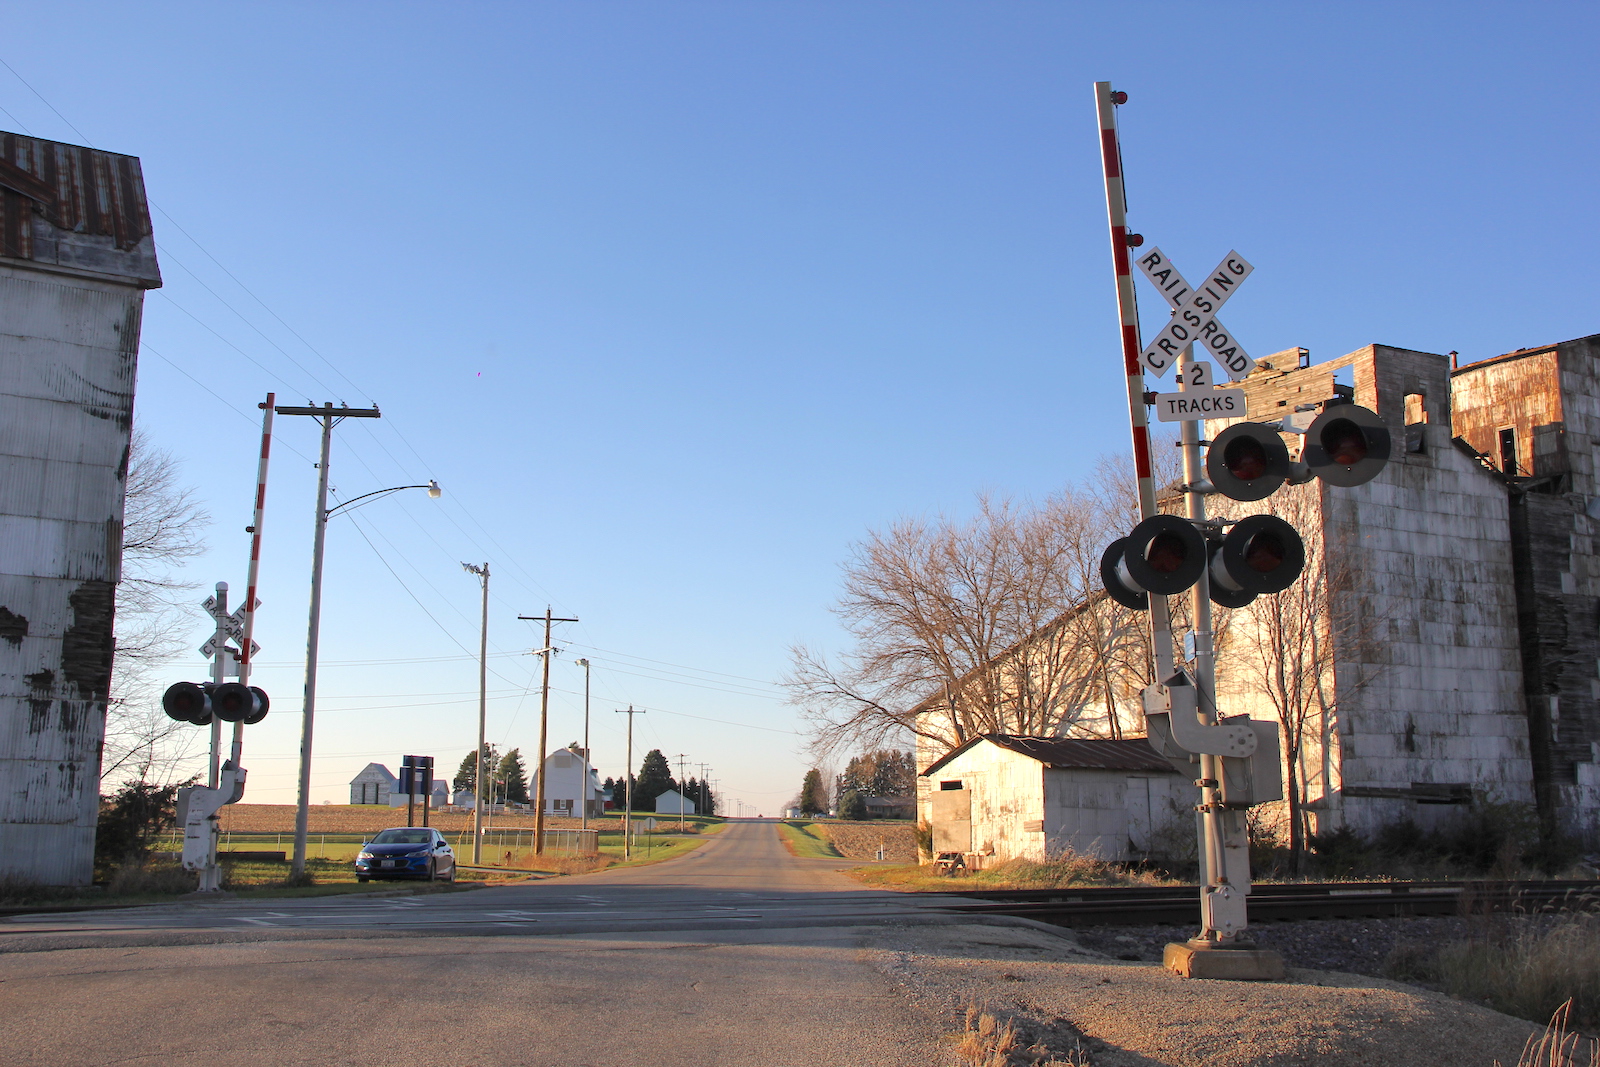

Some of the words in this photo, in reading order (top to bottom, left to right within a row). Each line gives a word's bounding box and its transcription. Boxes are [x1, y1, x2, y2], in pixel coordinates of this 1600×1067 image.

[1142, 252, 1188, 306] RAIL
[1200, 321, 1248, 373] ROAD
[1147, 259, 1245, 369] CROSSING
[1168, 396, 1235, 414] TRACKS
[1191, 367, 1205, 386] 2
